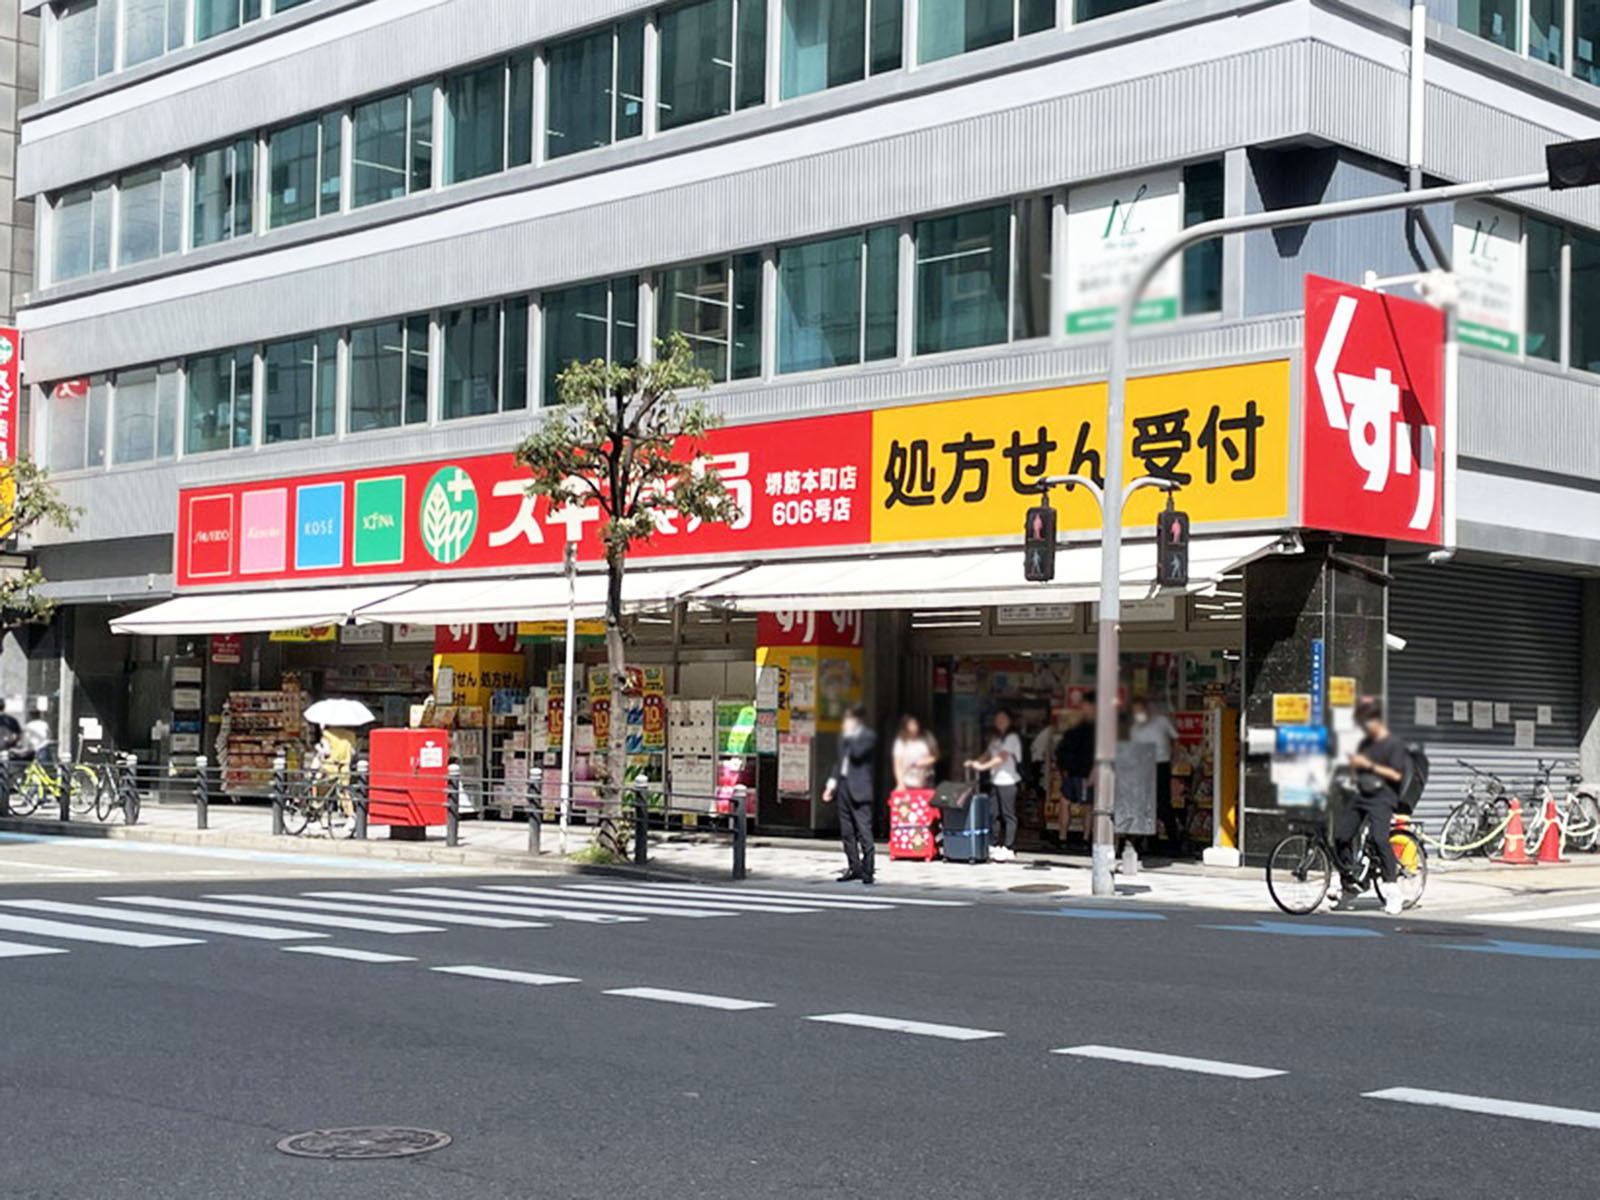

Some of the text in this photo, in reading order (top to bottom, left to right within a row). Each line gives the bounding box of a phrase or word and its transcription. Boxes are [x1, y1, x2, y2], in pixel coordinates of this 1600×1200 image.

[1314, 295, 1436, 530] くすり
[884, 400, 1264, 510] 処方せん受付
[765, 466, 858, 496] 堺筋本町店
[304, 518, 335, 536] KOSÉ
[772, 497, 851, 527] 606号店
